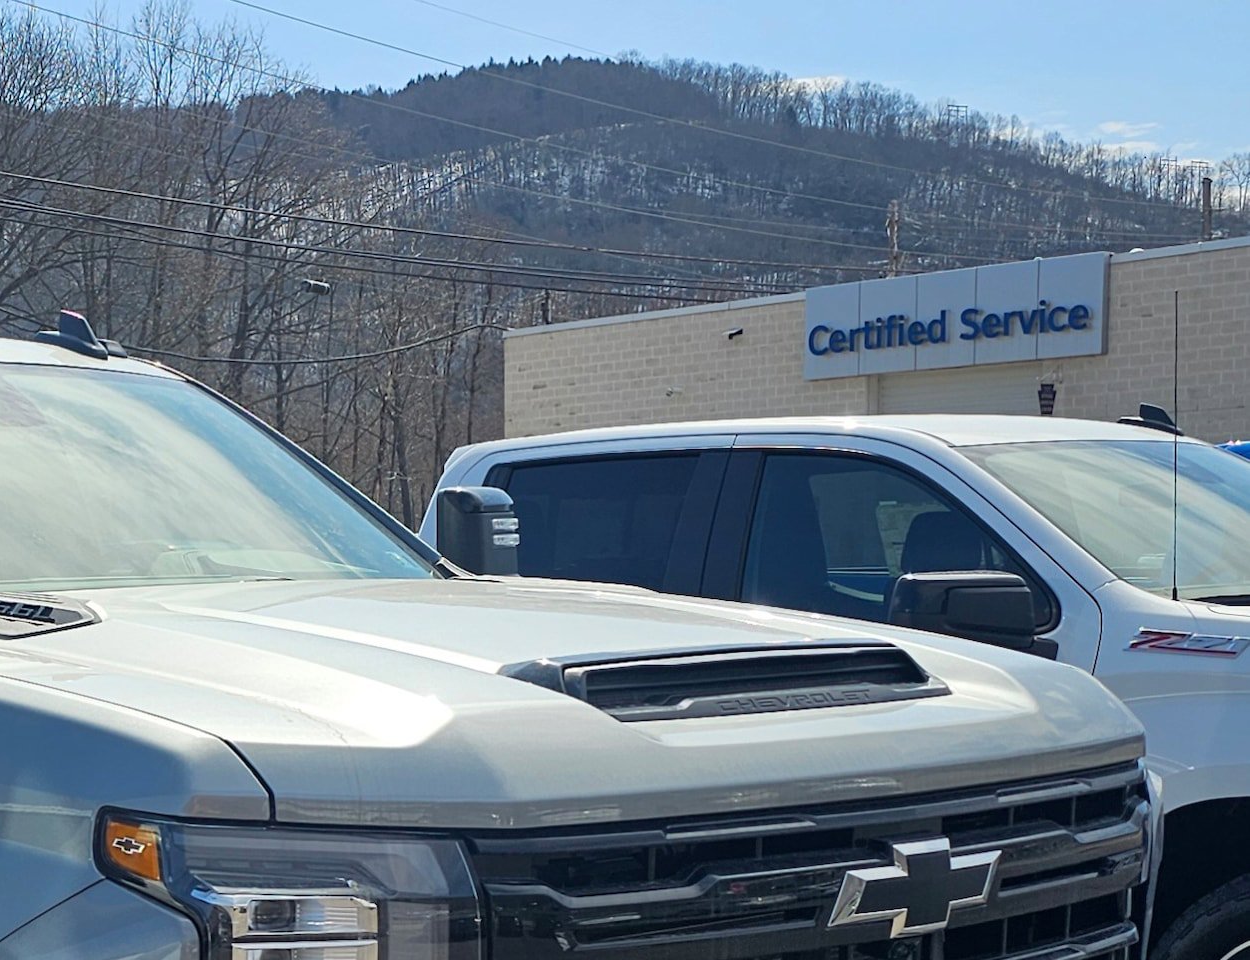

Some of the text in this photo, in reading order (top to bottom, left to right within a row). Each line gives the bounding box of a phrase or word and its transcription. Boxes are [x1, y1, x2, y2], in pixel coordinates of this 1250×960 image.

[808, 299, 1090, 356] Certified Service
[717, 689, 869, 712] CHEVROLET
